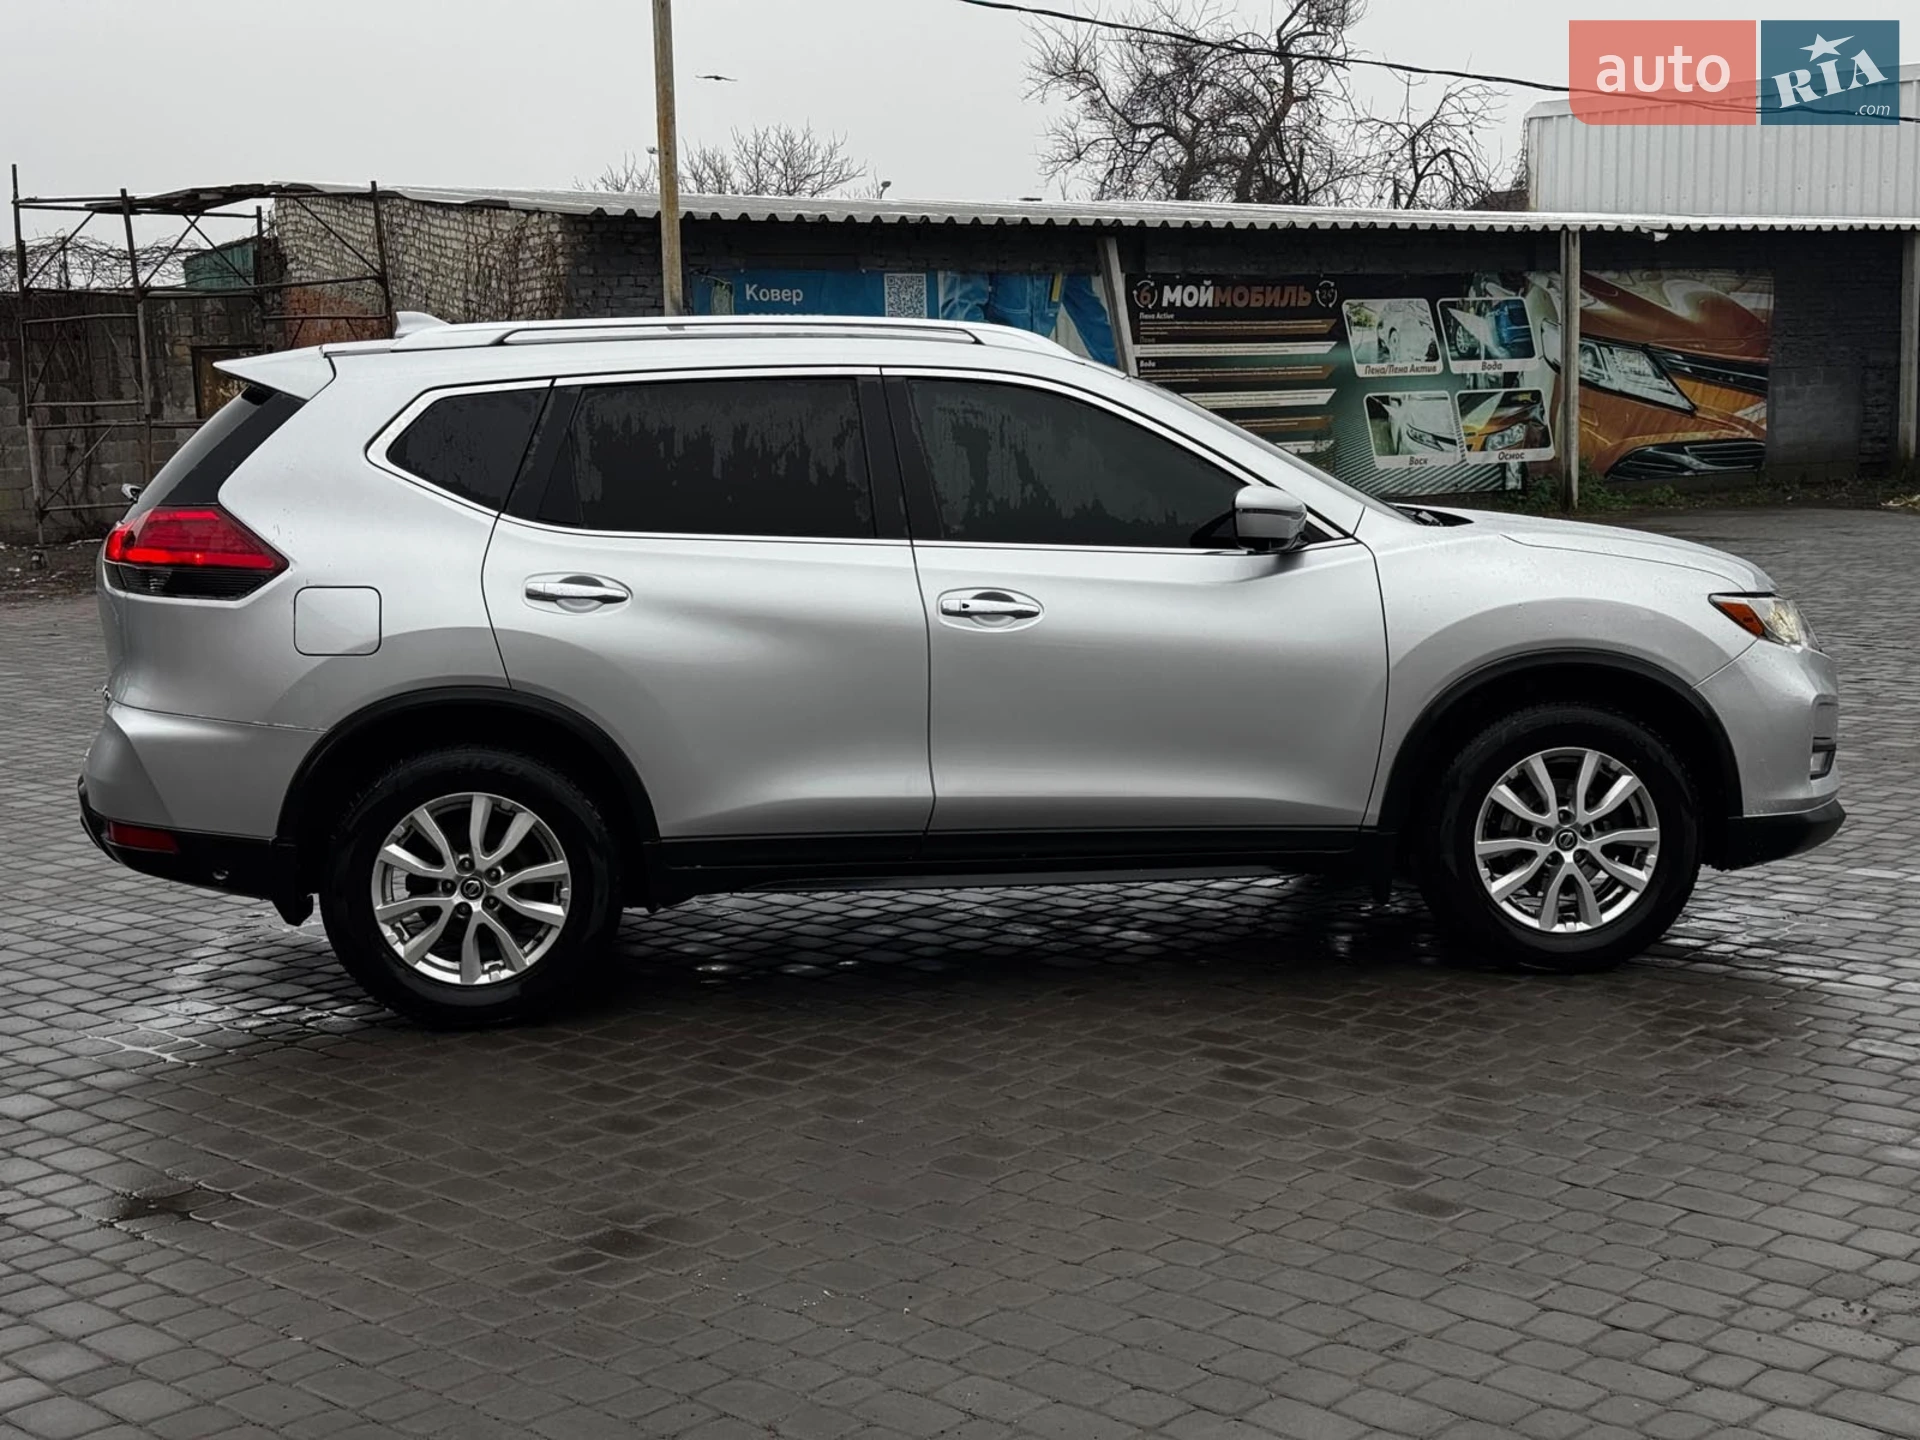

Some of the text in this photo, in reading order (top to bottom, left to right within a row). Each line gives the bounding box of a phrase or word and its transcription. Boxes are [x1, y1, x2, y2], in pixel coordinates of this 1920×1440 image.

[745, 283, 804, 306] Ковер
[1162, 280, 1312, 307] МОЙМОБИЛЬ
[1364, 364, 1437, 375] Пена/Пена Актив
[1481, 361, 1503, 371] Вода
[1498, 451, 1525, 461] Осмос
[1408, 457, 1429, 466] Воск
